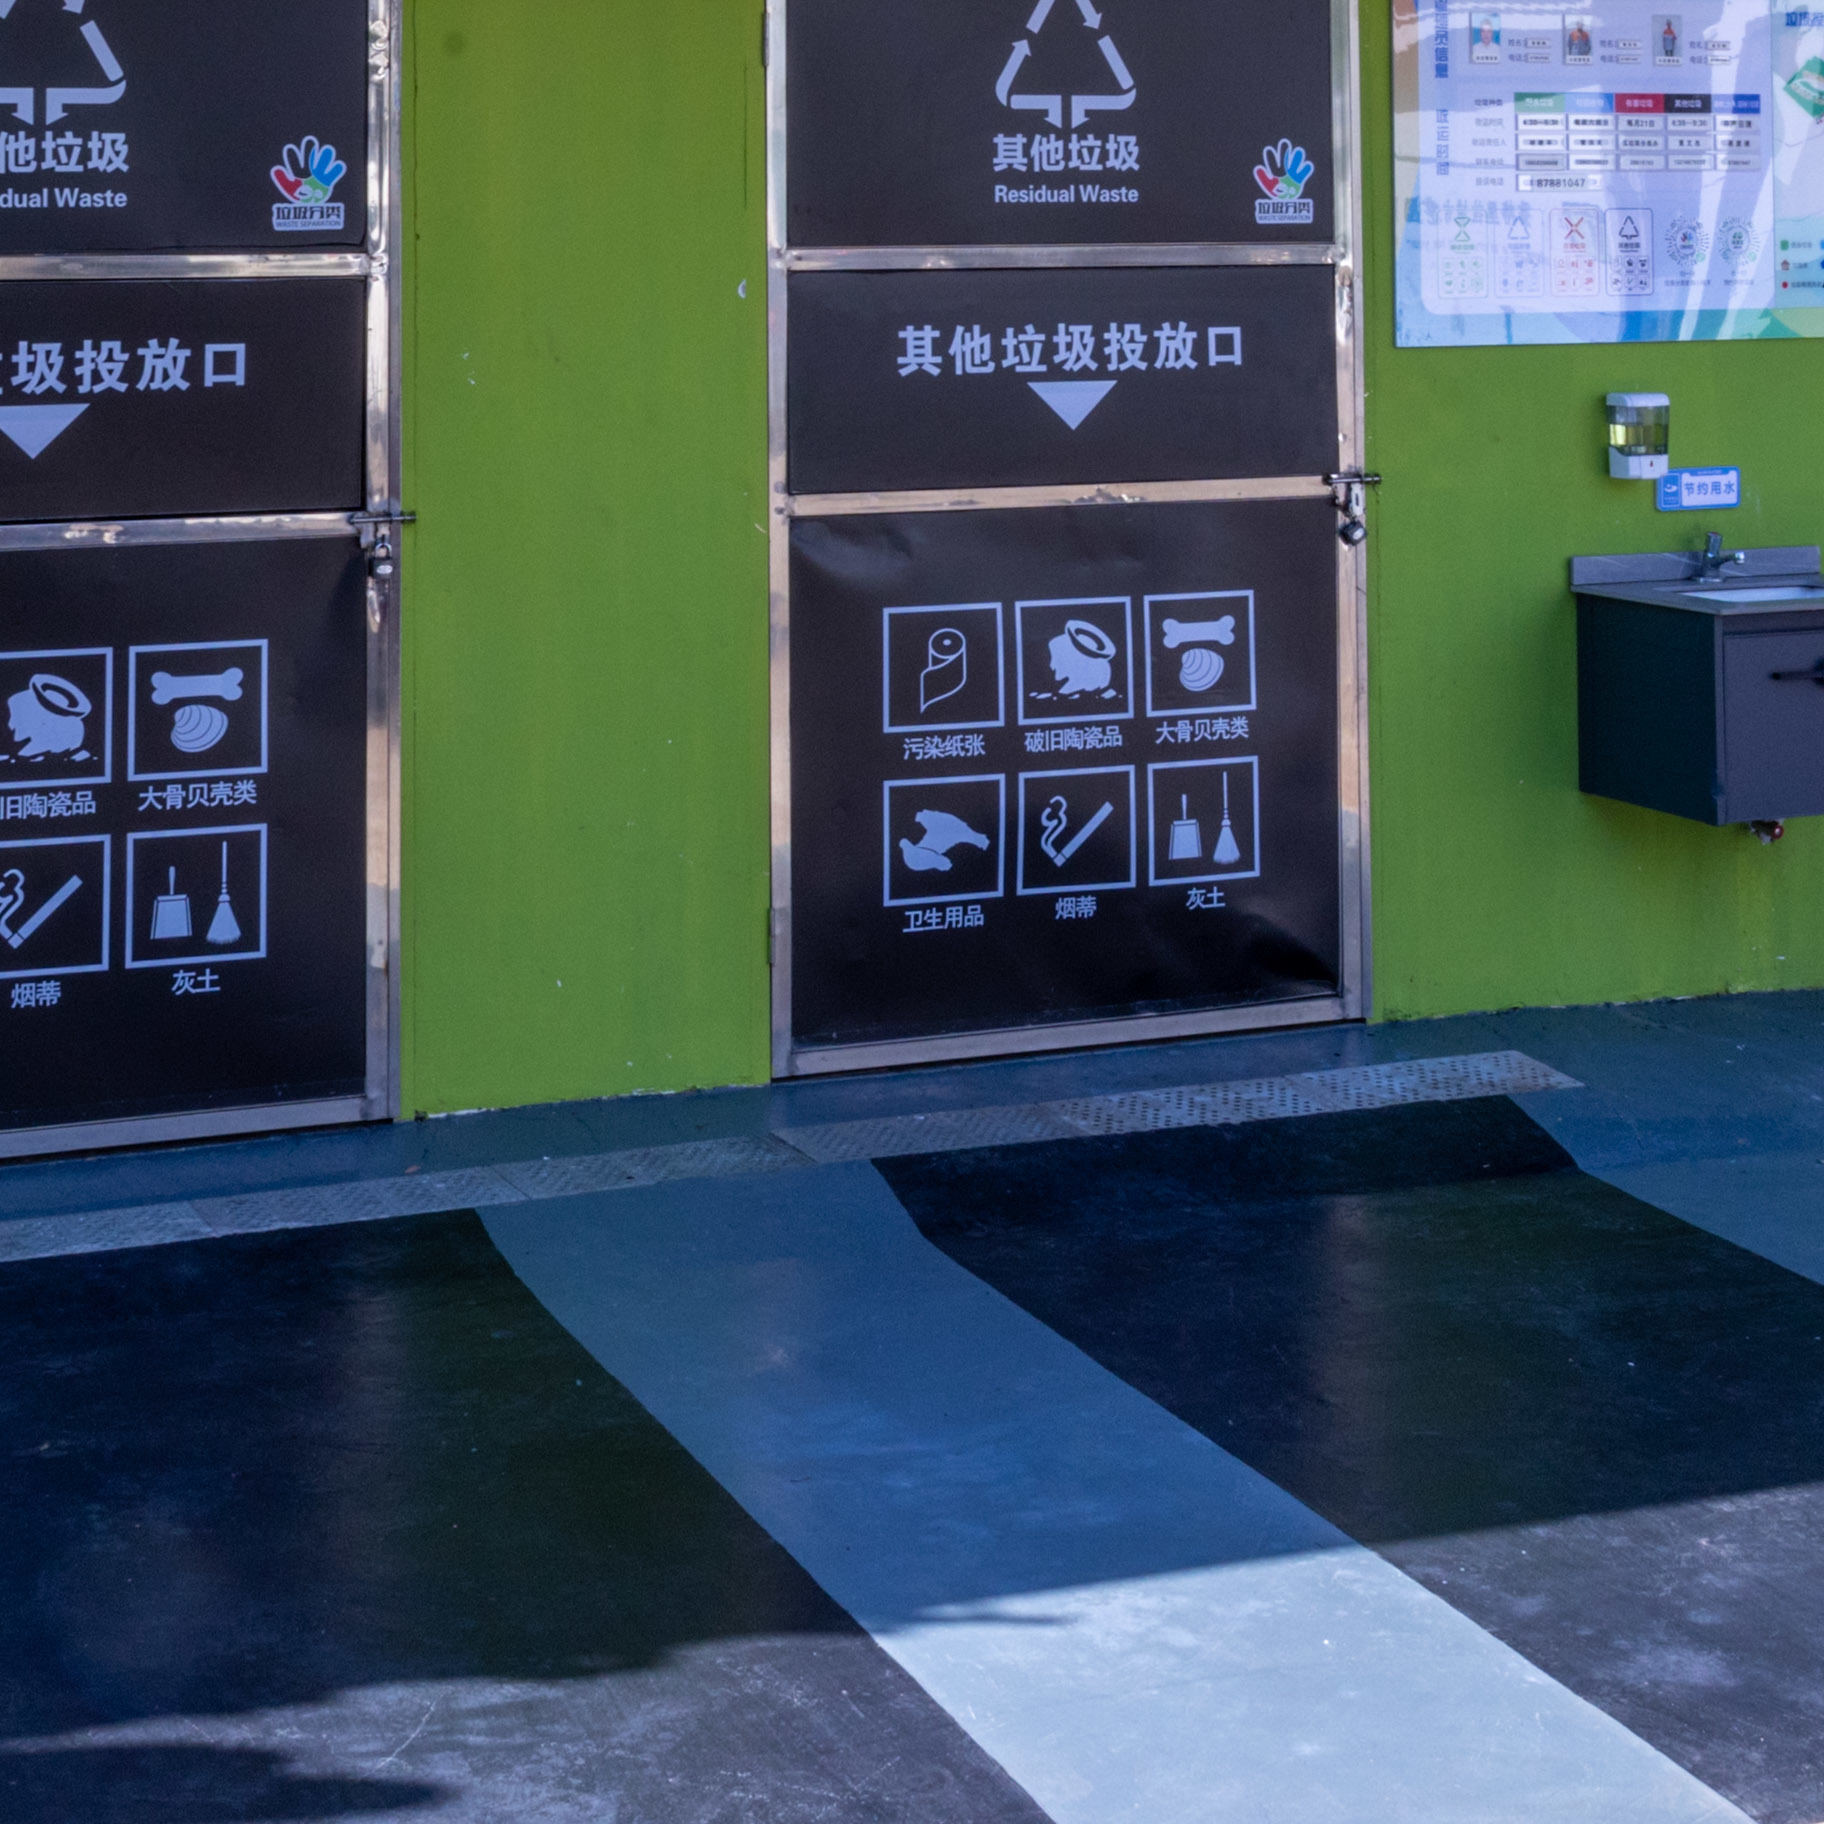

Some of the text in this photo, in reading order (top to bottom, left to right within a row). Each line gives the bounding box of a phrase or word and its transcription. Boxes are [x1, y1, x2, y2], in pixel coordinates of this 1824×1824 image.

[992, 134, 1140, 172] 其他垃圾
[54, 188, 128, 208] Waste
[994, 185, 1139, 203] Residual Waste
[897, 322, 1243, 377] 其他垃圾投放口
[1683, 480, 1736, 496] 节约用水
[1024, 725, 1123, 754] 破旧陶瓷品
[1155, 716, 1249, 744] 大骨贝壳类
[902, 734, 985, 760] 污染纸张
[137, 780, 257, 812] 大骨贝壳类
[1055, 895, 1097, 920] 烟蒂
[1185, 886, 1226, 910] 灰土
[902, 905, 984, 933] 卫生用品
[11, 980, 62, 1008] 烟蒂
[171, 969, 221, 995] 灰土
